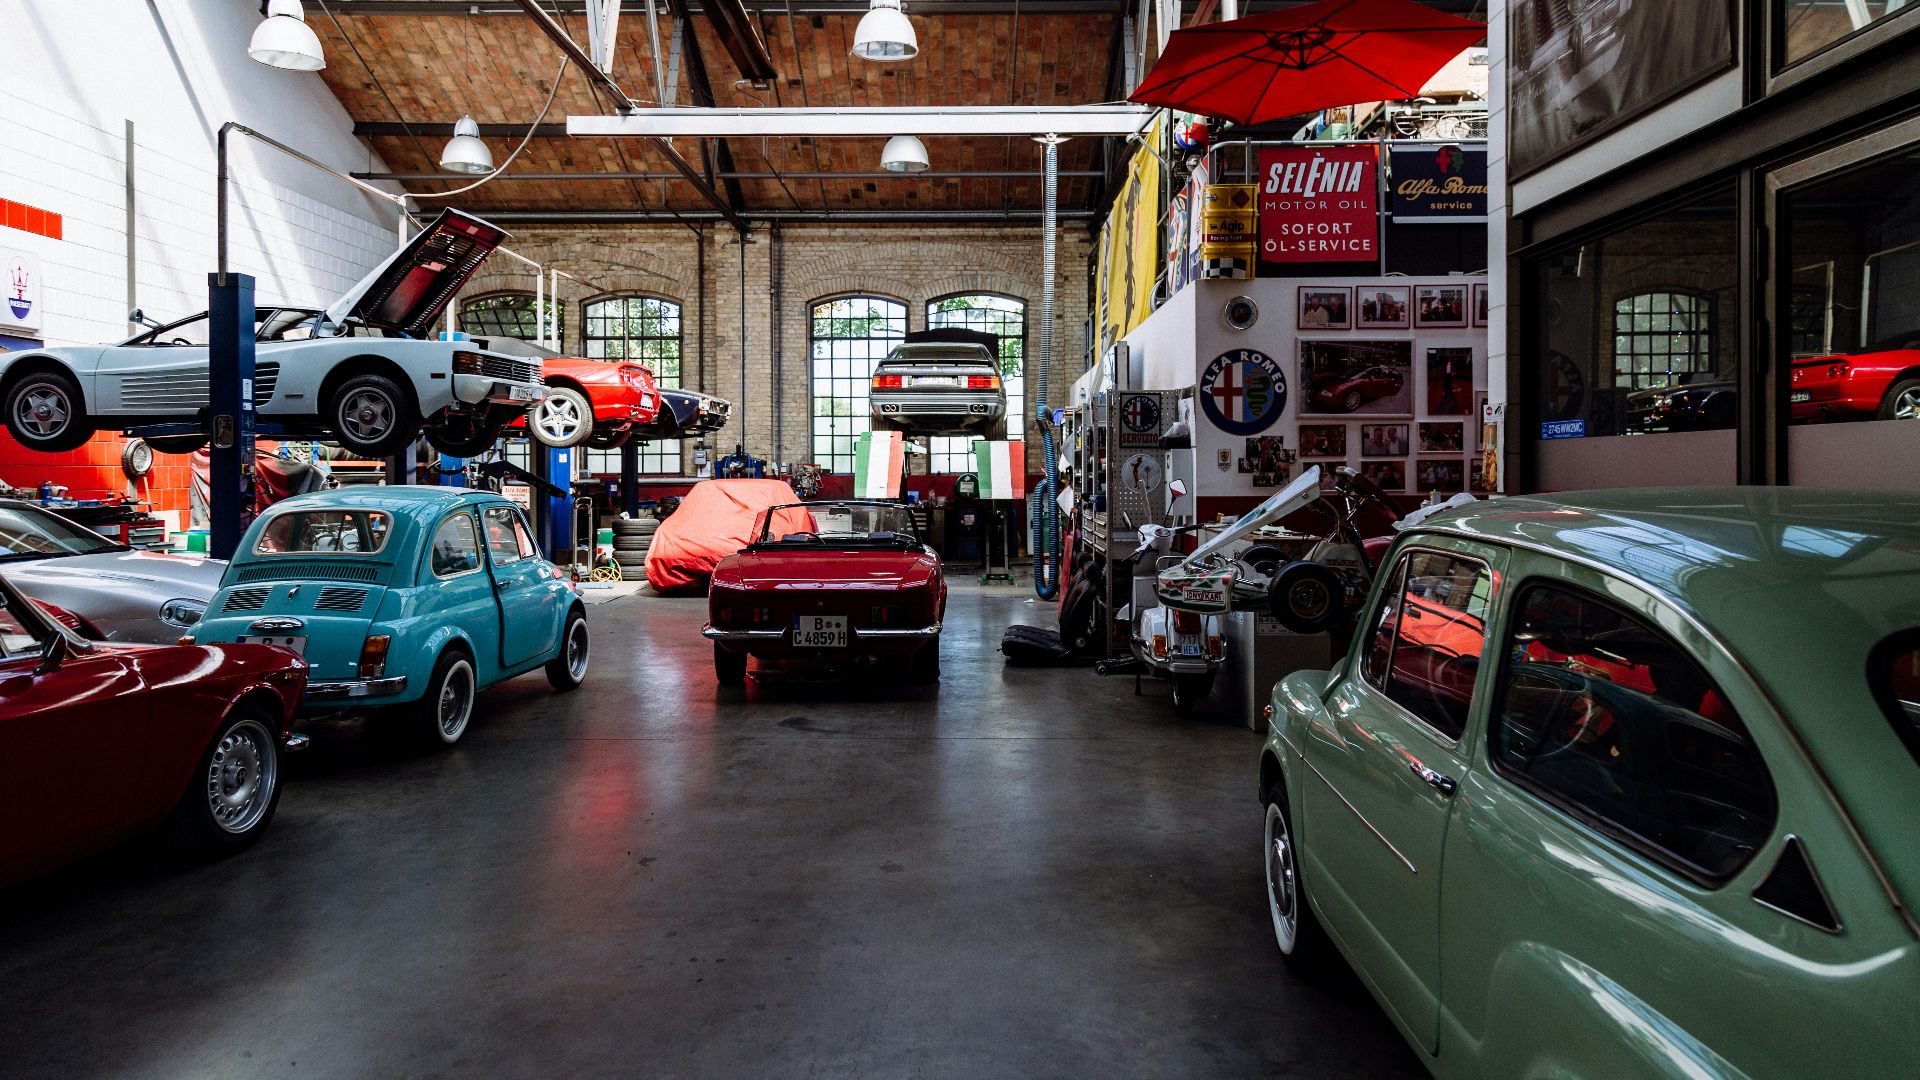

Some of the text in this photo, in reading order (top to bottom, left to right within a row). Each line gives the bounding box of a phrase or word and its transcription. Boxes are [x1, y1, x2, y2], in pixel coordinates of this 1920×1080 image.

[1397, 178, 1440, 201] Alfa
[1265, 200, 1368, 210] MOTOR OIL
[1430, 200, 1473, 210] service
[1219, 220, 1245, 234] Agip
[1281, 222, 1353, 235] SOFORT
[1264, 238, 1371, 252] ÖL-SERVICE
[1202, 350, 1285, 395] ALFA ROMEO
[1122, 432, 1159, 444] SERVIZIO
[814, 617, 824, 631] B
[793, 631, 846, 646] C 4859 H
[1183, 645, 1199, 656] HEN
